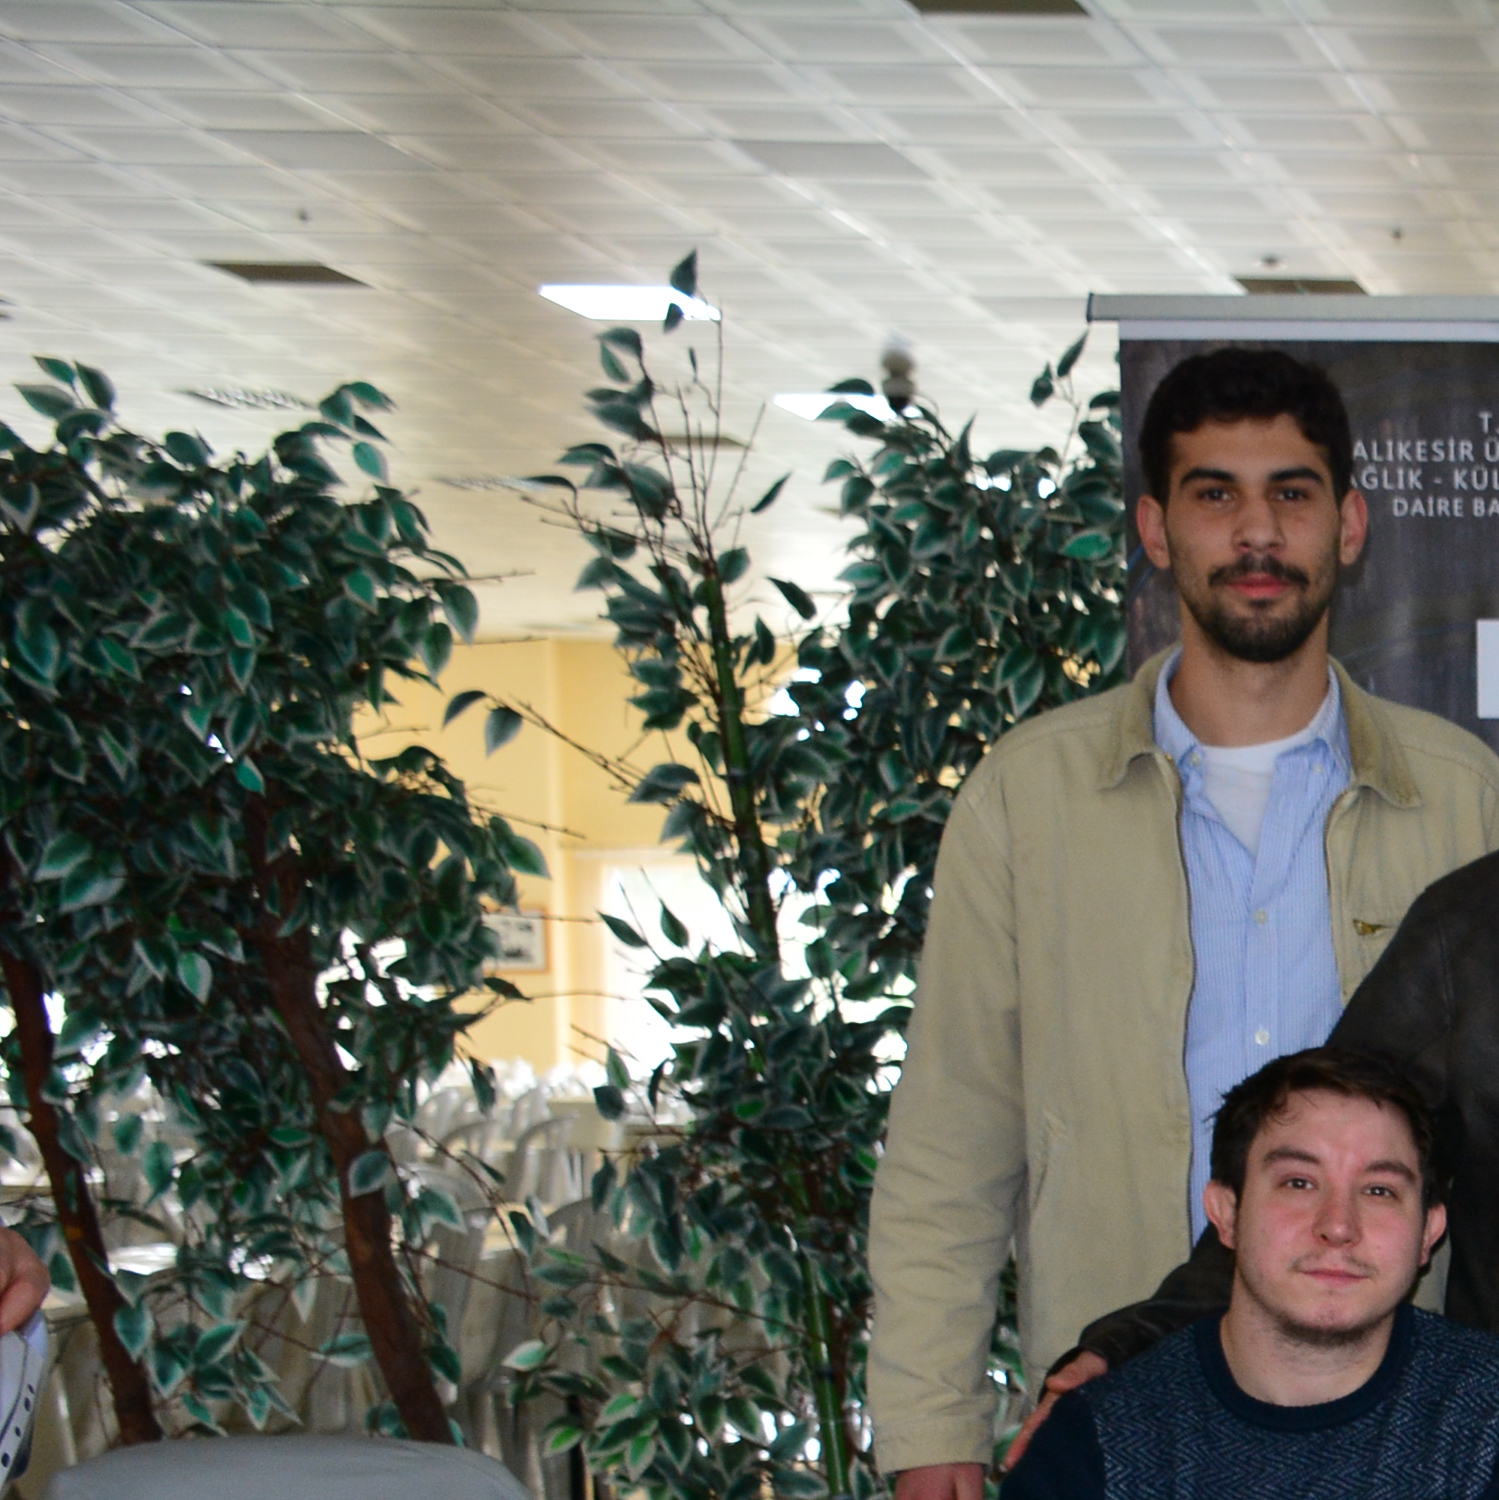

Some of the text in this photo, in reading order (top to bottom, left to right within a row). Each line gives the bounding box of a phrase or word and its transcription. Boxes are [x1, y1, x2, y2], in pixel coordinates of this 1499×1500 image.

[1352, 437, 1474, 463] ALIKESİR
[1350, 464, 1424, 491] ĞLIK
[1392, 494, 1464, 519] DAİRE
